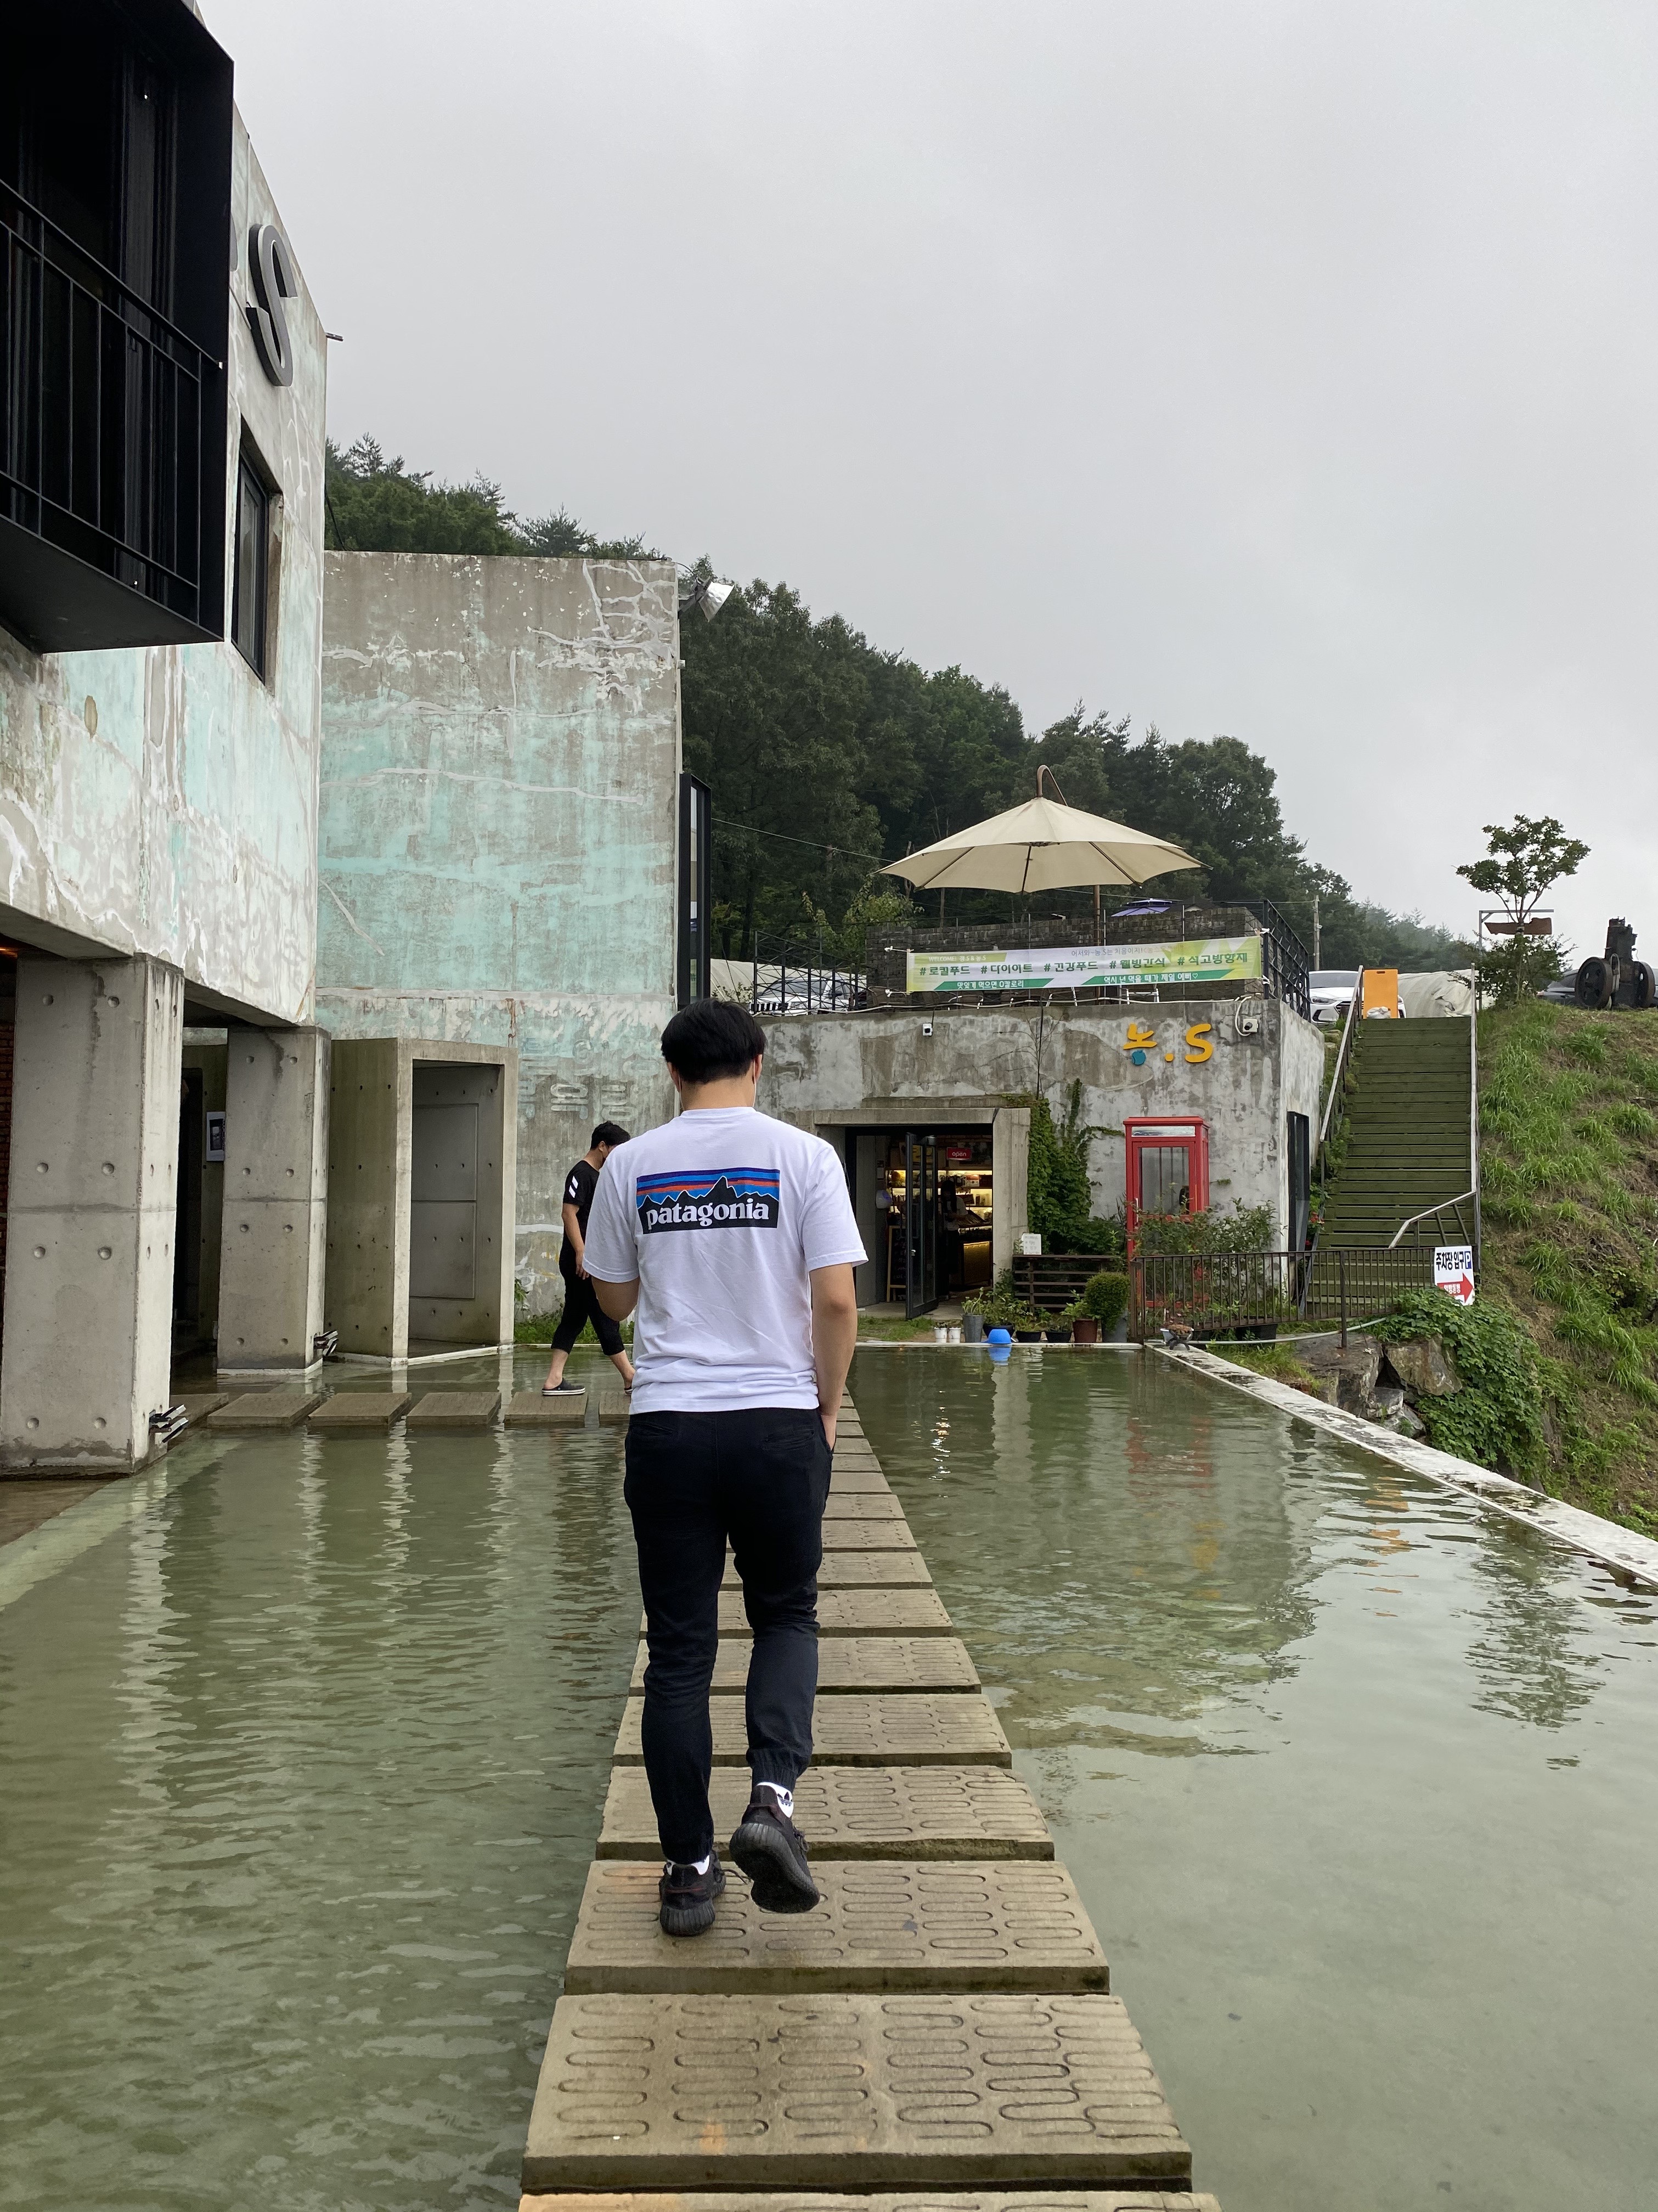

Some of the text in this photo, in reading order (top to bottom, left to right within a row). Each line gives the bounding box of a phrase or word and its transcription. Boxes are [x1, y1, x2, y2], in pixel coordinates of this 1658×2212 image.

[957, 981, 976, 989] 맛있게
[999, 980, 1024, 988] 0칼로리
[1128, 975, 1142, 983] 먹을
[1144, 974, 1159, 983] 때가
[1161, 973, 1175, 981] 제일
[646, 1198, 769, 1230] patagonia
[1436, 1251, 1453, 1271] 주차장
[1454, 1251, 1464, 1269] 입구
